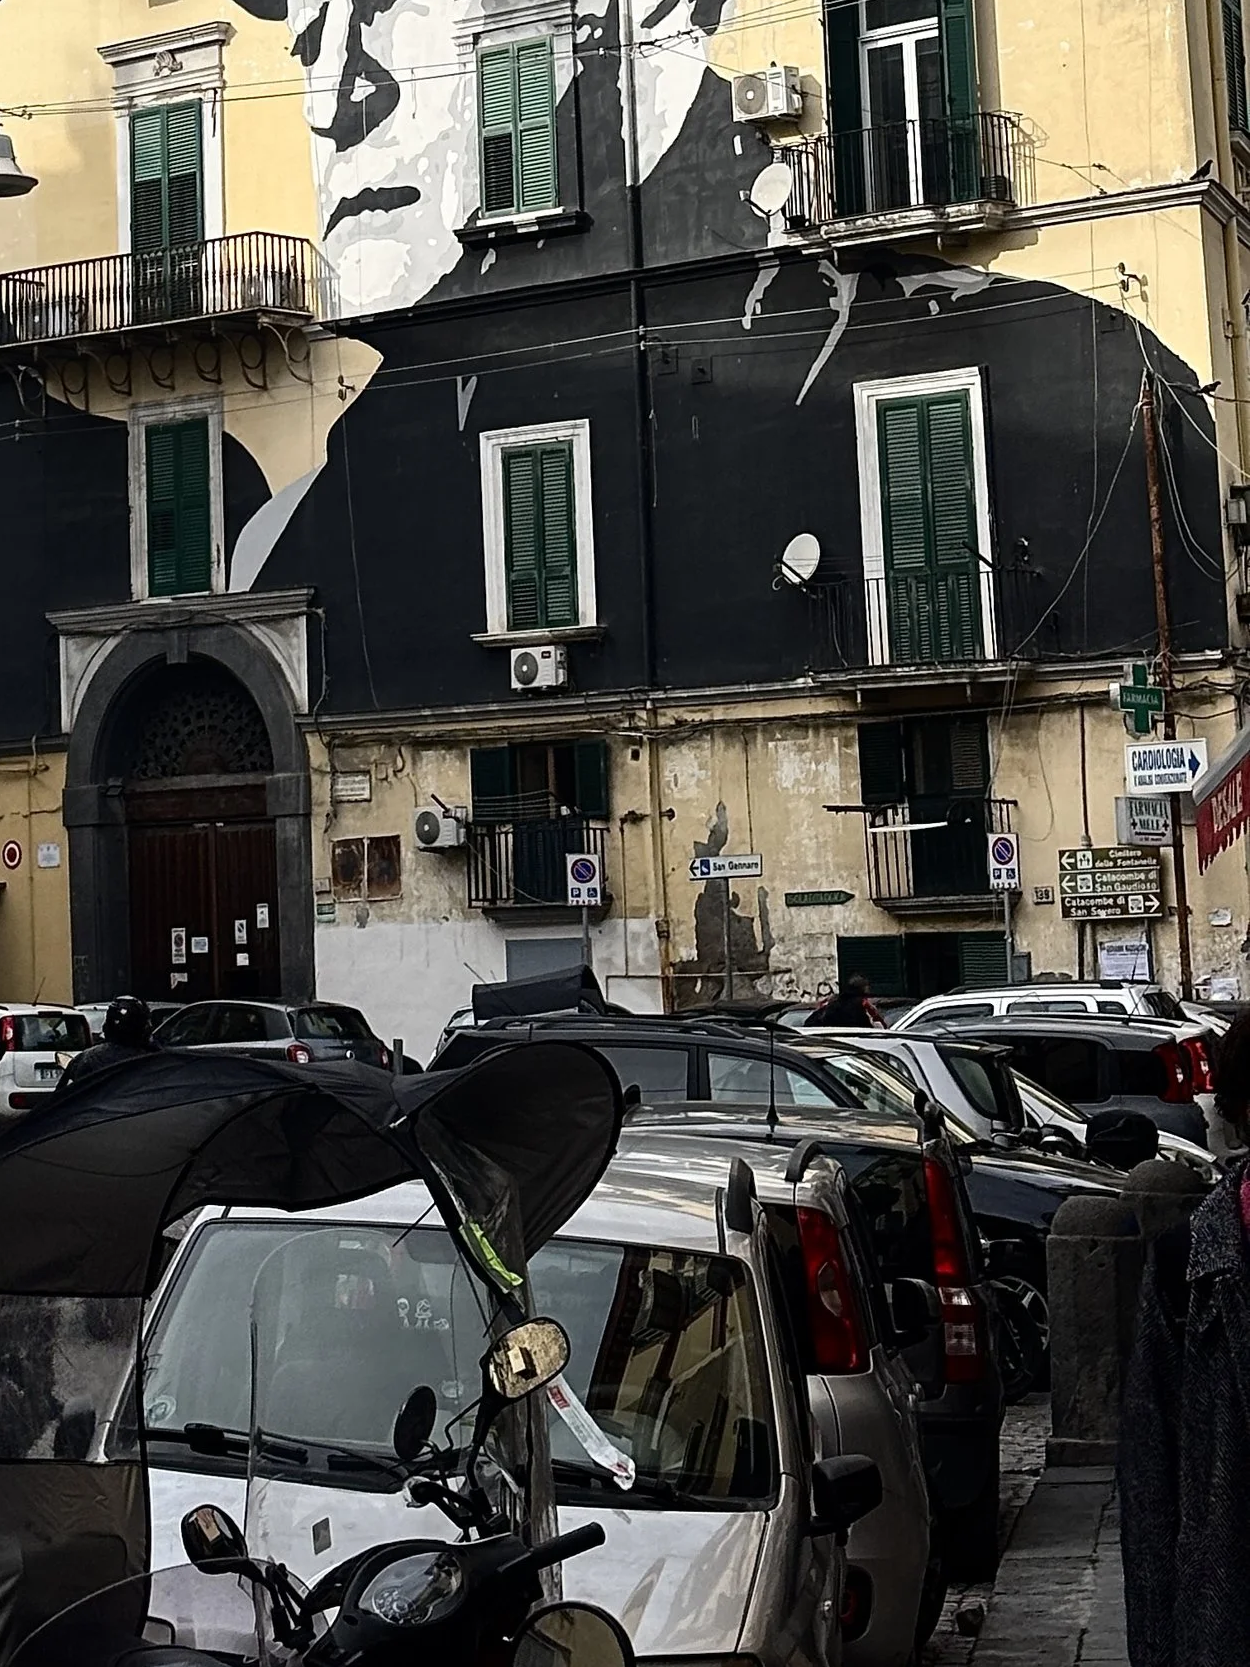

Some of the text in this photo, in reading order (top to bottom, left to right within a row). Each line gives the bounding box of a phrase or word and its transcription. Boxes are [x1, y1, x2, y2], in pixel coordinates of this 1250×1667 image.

[1122, 691, 1160, 705] FARMACIA
[1132, 747, 1186, 771] CARDIOLOGIA
[712, 860, 759, 872] San Gennaro
[1095, 870, 1157, 882] Catacombe di
[1095, 882, 1157, 893] San Gaudioso
[1064, 896, 1126, 907] Catacombe di
[1070, 907, 1087, 916] San
